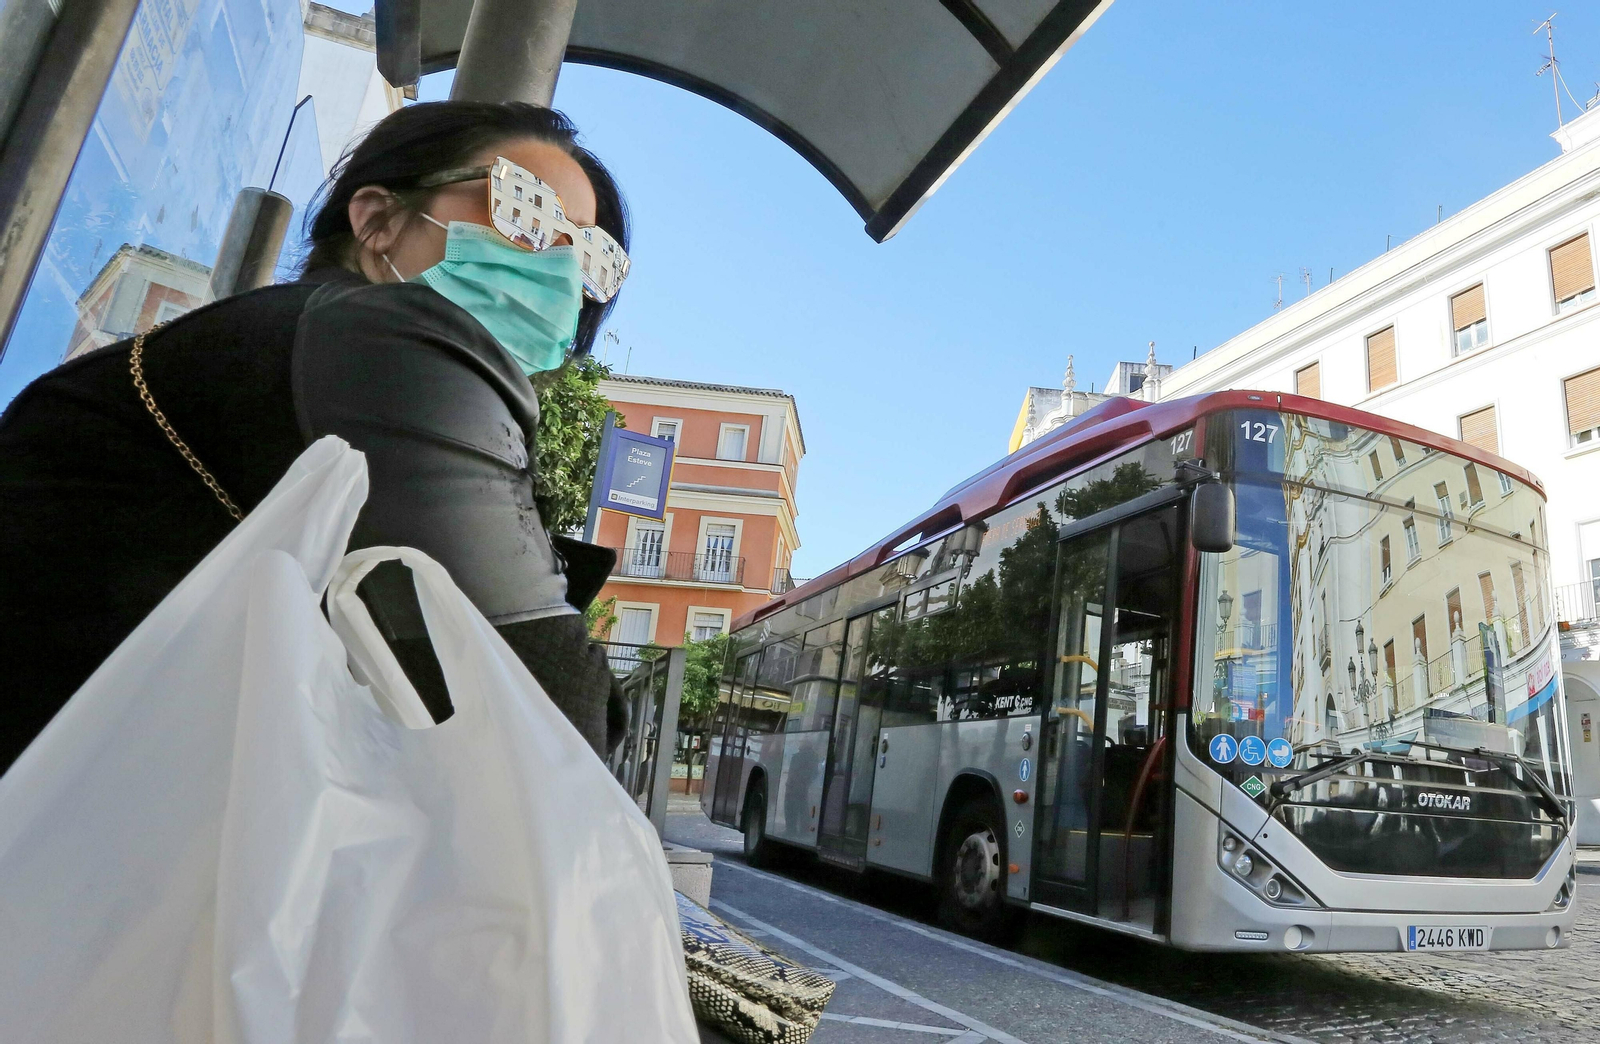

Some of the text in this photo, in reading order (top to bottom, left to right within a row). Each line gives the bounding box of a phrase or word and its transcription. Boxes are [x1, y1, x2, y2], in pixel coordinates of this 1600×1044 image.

[1240, 420, 1279, 444] 127
[1170, 430, 1193, 455] 127
[631, 447, 651, 458] Plaza
[627, 455, 652, 467] Esteve
[618, 495, 655, 508] Interparking
[995, 695, 1014, 708] KENT
[1418, 792, 1471, 811] OTOKAR
[1417, 928, 1454, 948] 2446
[1458, 928, 1484, 947] KWD
